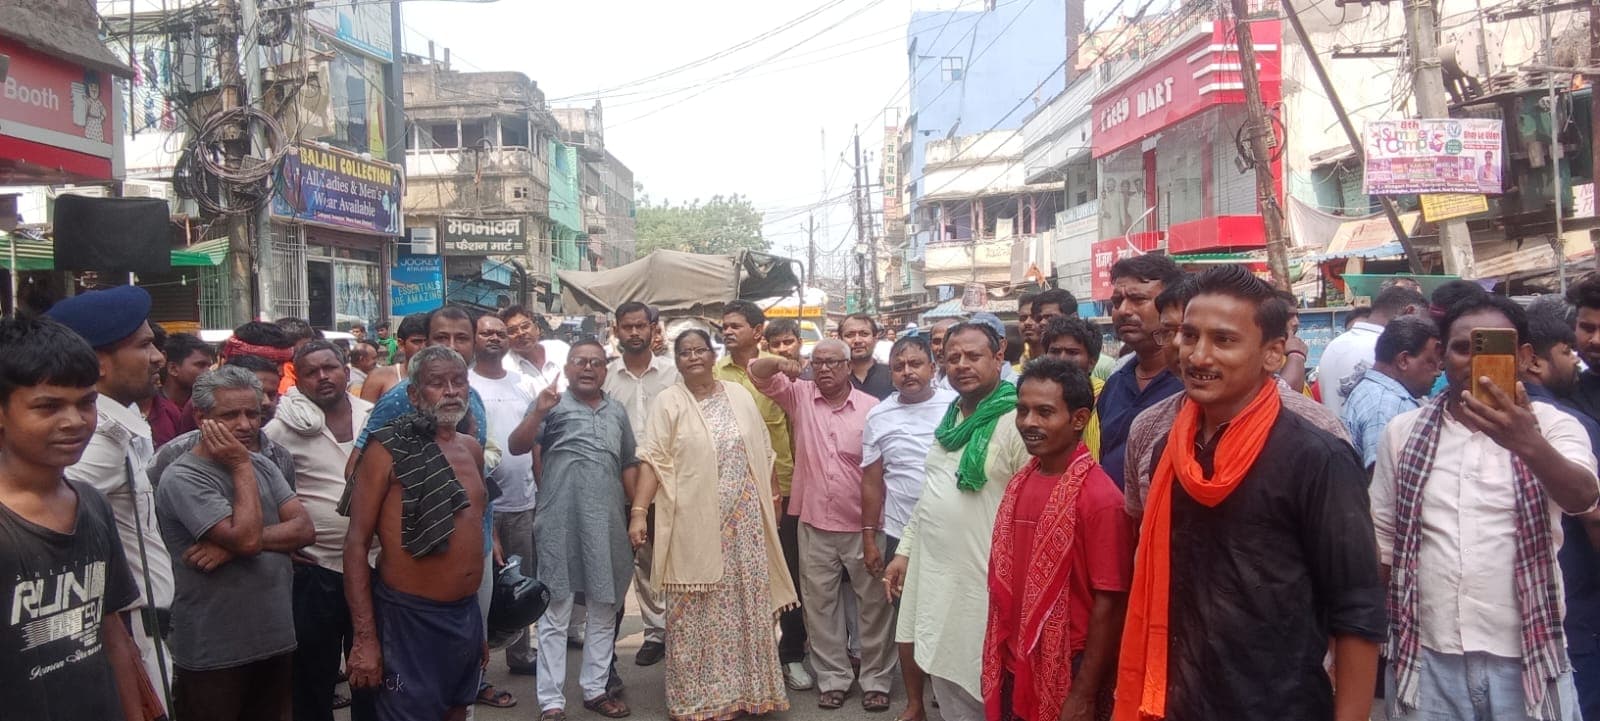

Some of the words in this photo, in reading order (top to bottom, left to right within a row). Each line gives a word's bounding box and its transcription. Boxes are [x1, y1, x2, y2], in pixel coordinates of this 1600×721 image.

[4, 76, 59, 112] Booth
[1137, 76, 1174, 118] MART
[1386, 137, 1427, 153] Camp
[300, 147, 337, 172] BALAJI
[340, 157, 392, 186] COLLECTION
[306, 170, 320, 186] All
[350, 181, 357, 195] &
[359, 183, 382, 201] Men's
[339, 197, 376, 217] Available
[400, 257, 440, 267] JOCKEY
[11, 560, 106, 626] RUN
